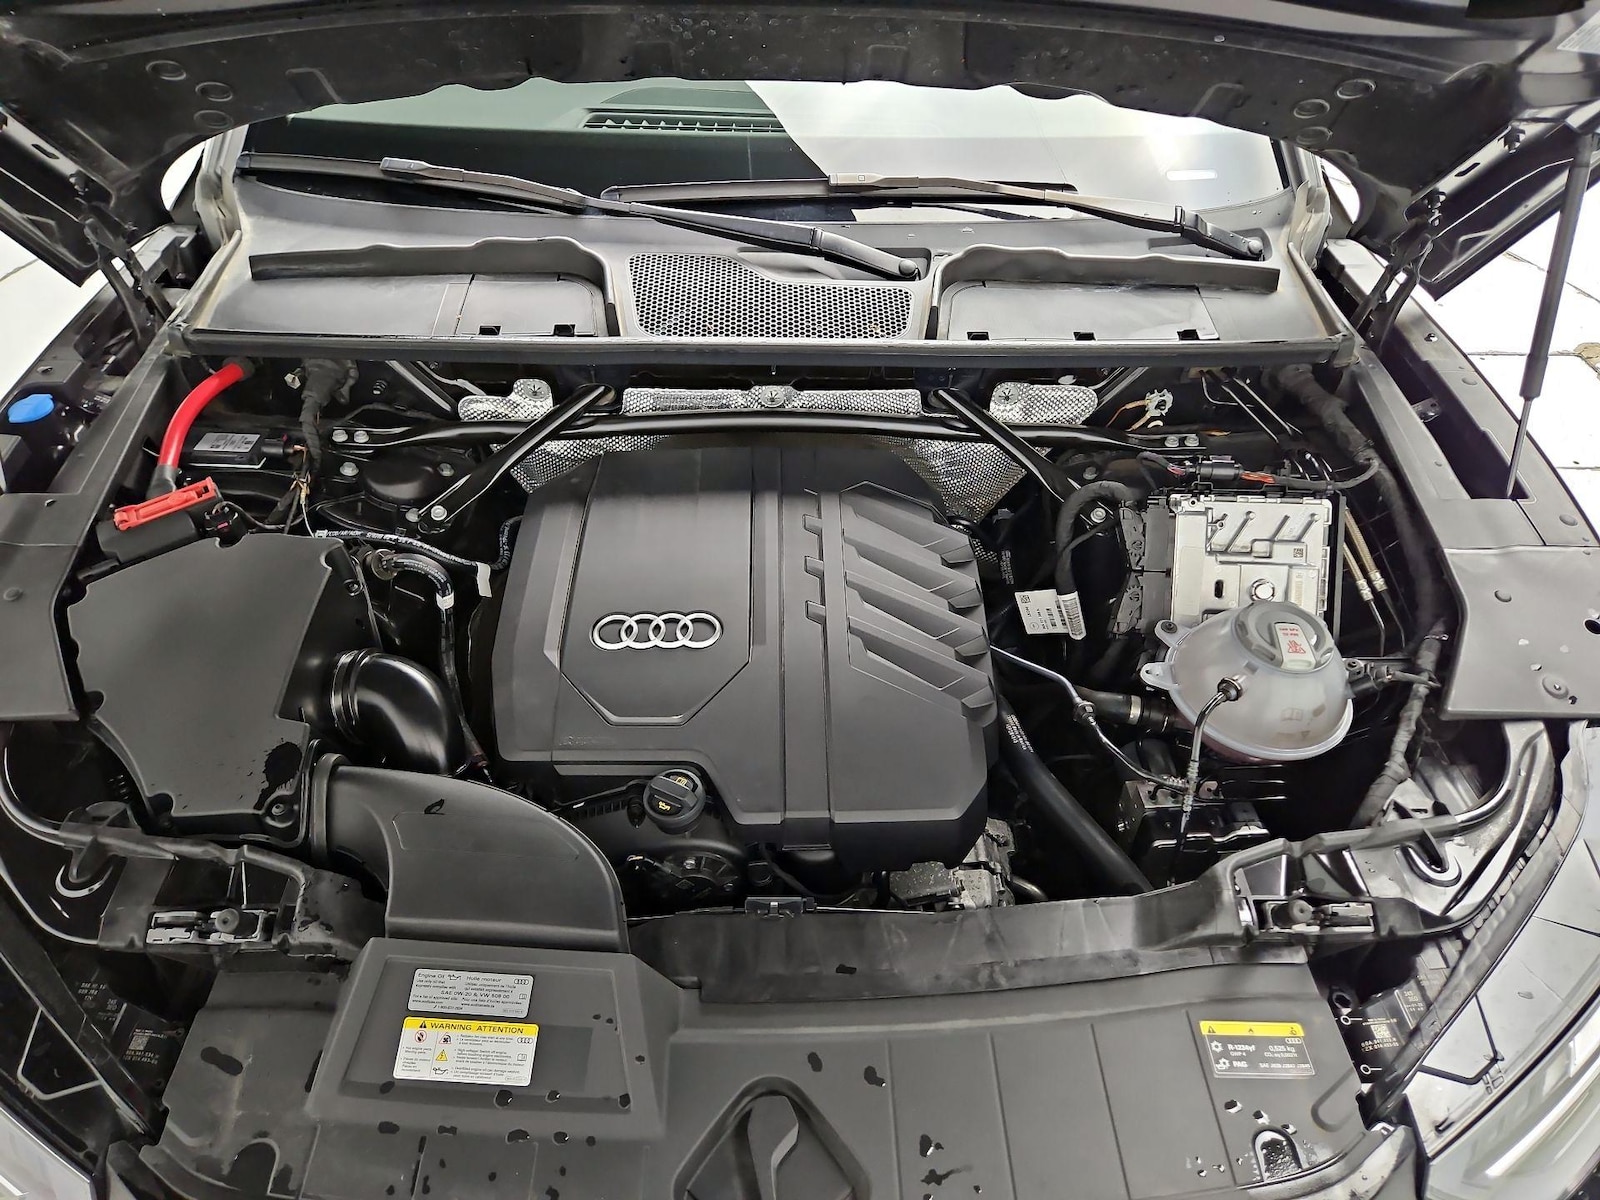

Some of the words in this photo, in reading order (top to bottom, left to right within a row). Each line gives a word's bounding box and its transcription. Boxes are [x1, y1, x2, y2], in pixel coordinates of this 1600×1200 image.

[431, 1022, 472, 1031] WARNING
[477, 1024, 524, 1034] ATTENTION
[1227, 1043, 1256, 1052] R-1234yf
